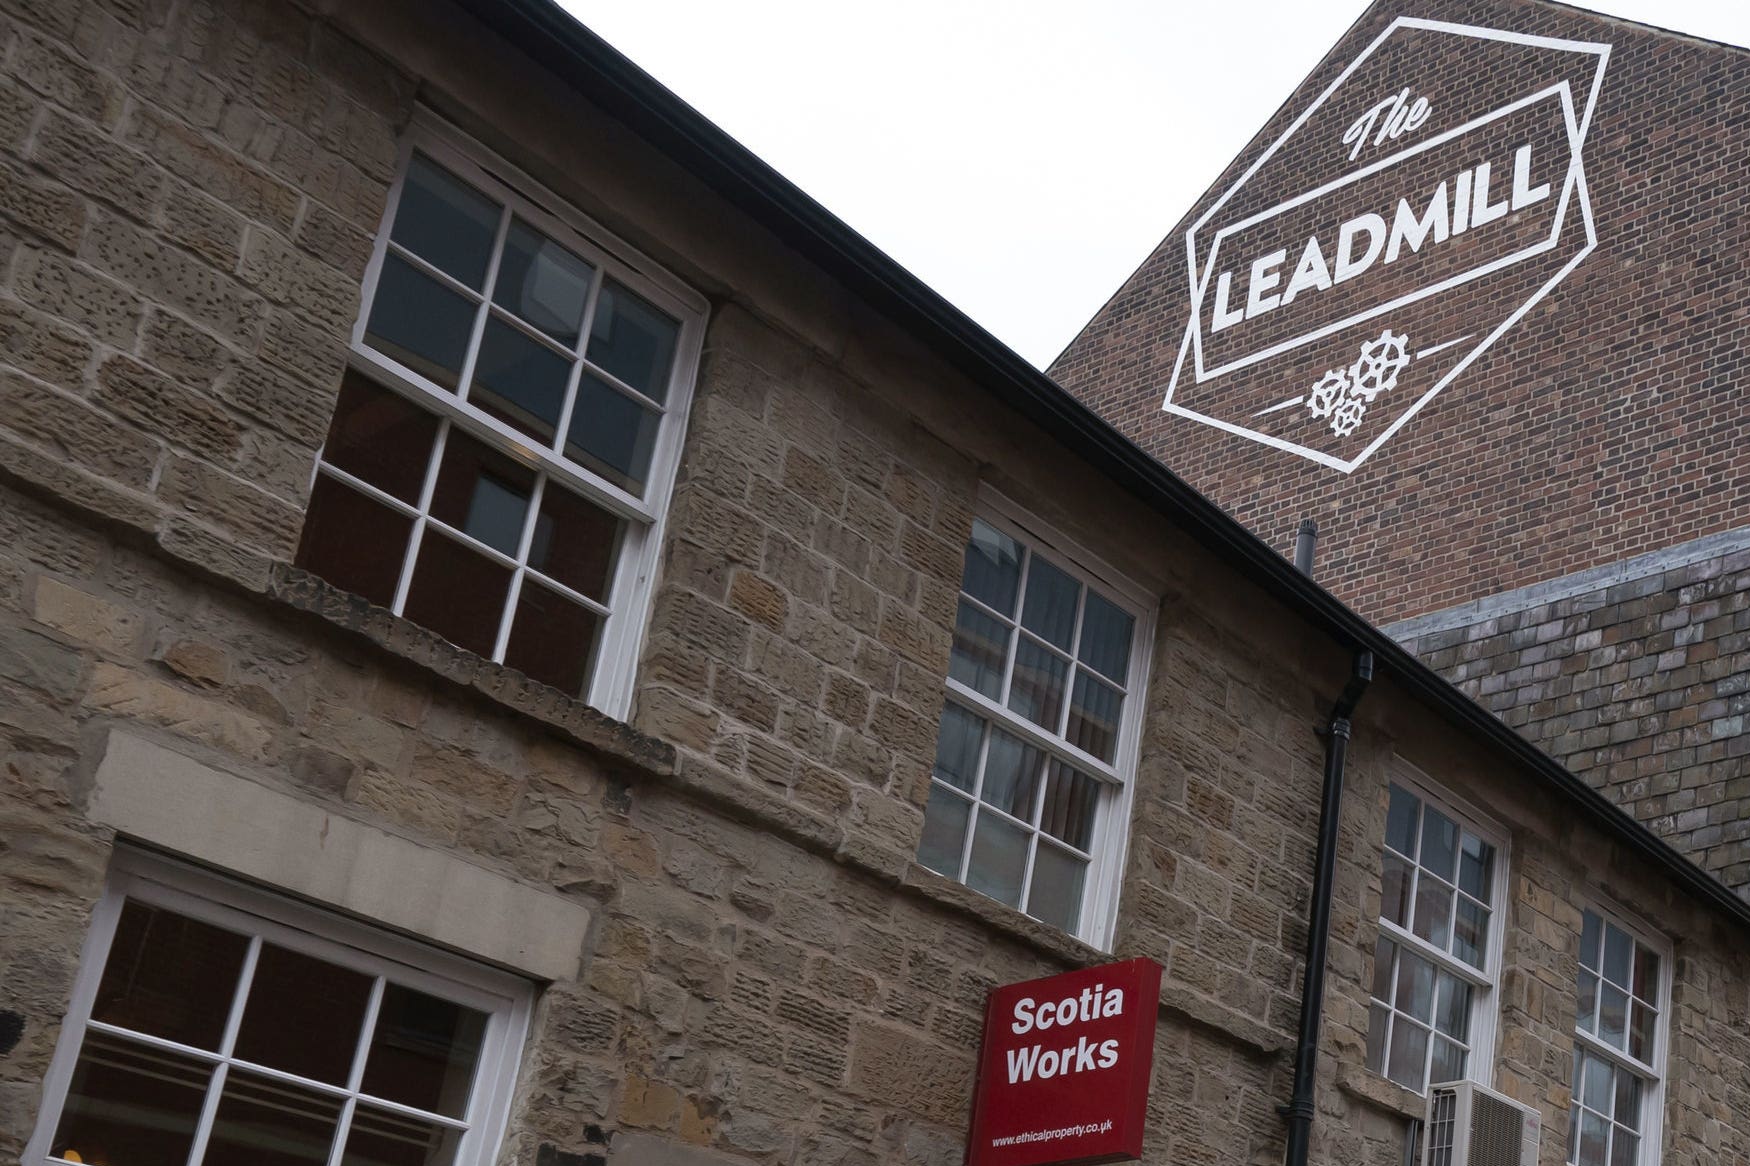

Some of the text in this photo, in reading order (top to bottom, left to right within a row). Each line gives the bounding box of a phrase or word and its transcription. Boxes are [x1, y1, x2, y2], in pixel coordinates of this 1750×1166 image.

[1342, 86, 1432, 161] The
[1211, 144, 1551, 334] LEADMILL
[1011, 983, 1124, 1035] Scotia
[1006, 1036, 1119, 1085] Works
[992, 1119, 1112, 1147] www.ethicalproperty.co.uk
